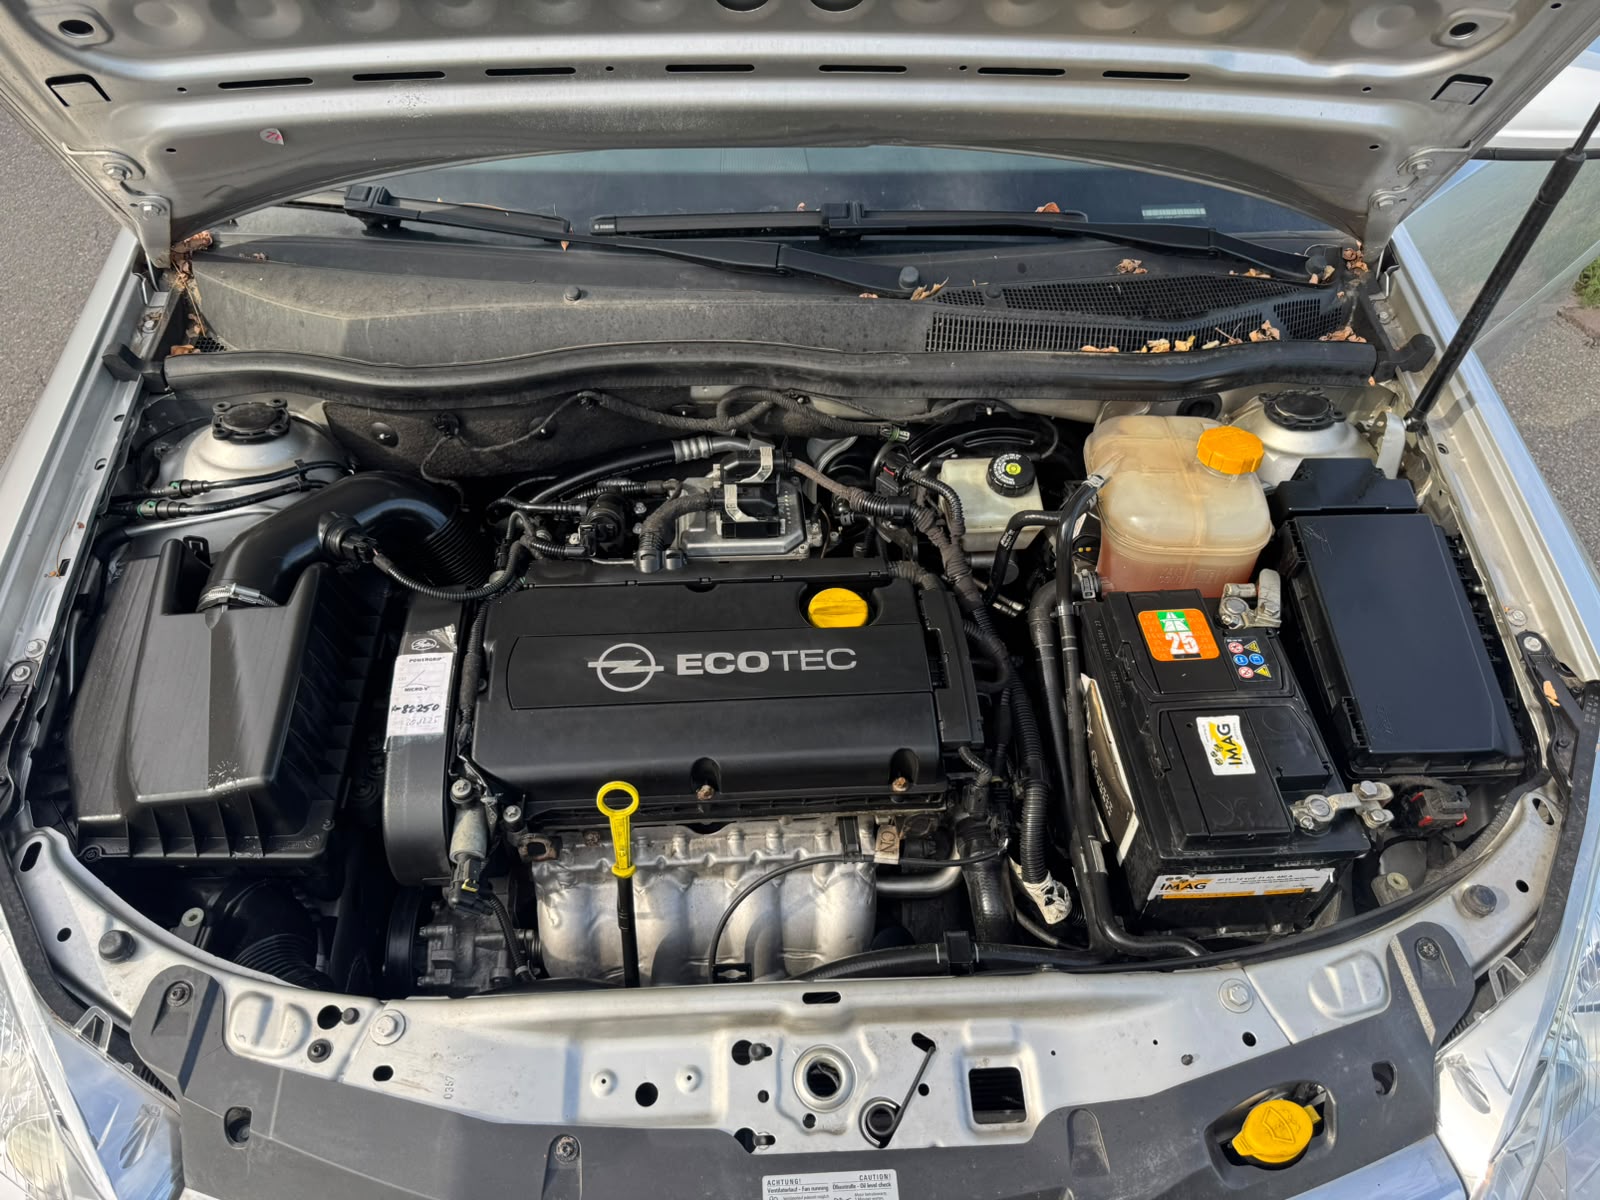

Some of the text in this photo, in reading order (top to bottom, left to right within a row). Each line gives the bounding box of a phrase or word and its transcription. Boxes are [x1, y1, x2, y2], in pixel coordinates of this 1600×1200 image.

[1165, 631, 1200, 655] 25
[676, 647, 857, 676] ECOTEC
[1217, 723, 1243, 765] IMAG
[1160, 882, 1207, 891] IMAG
[767, 1178, 801, 1186] ACHTUNG!
[859, 1173, 891, 1181] CAUTION!
